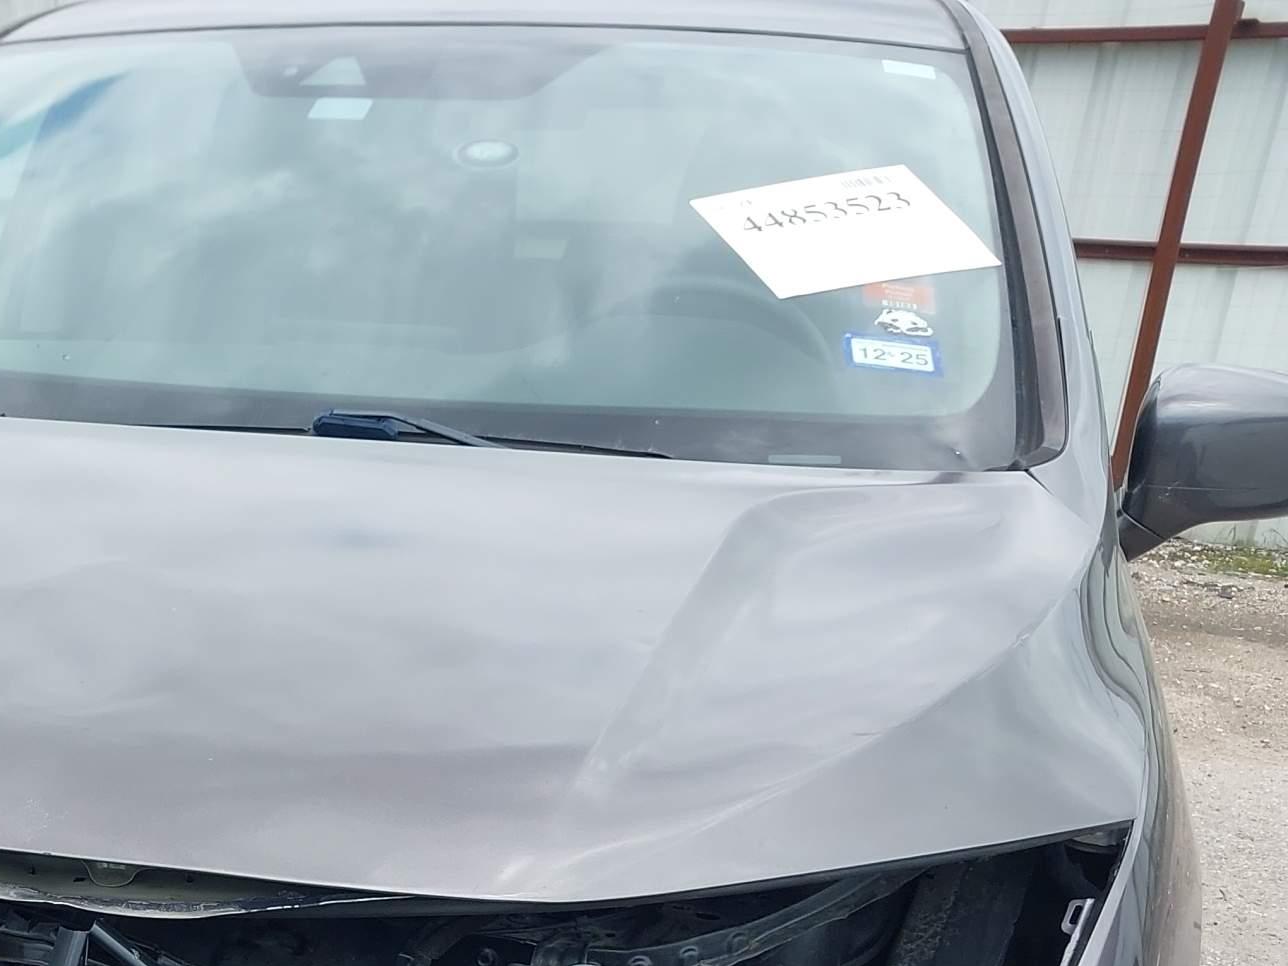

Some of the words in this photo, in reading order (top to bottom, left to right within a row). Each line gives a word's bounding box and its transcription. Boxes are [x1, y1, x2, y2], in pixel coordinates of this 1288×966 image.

[743, 191, 911, 233] 44853523
[858, 347, 887, 361] 12
[899, 351, 929, 366] 25
